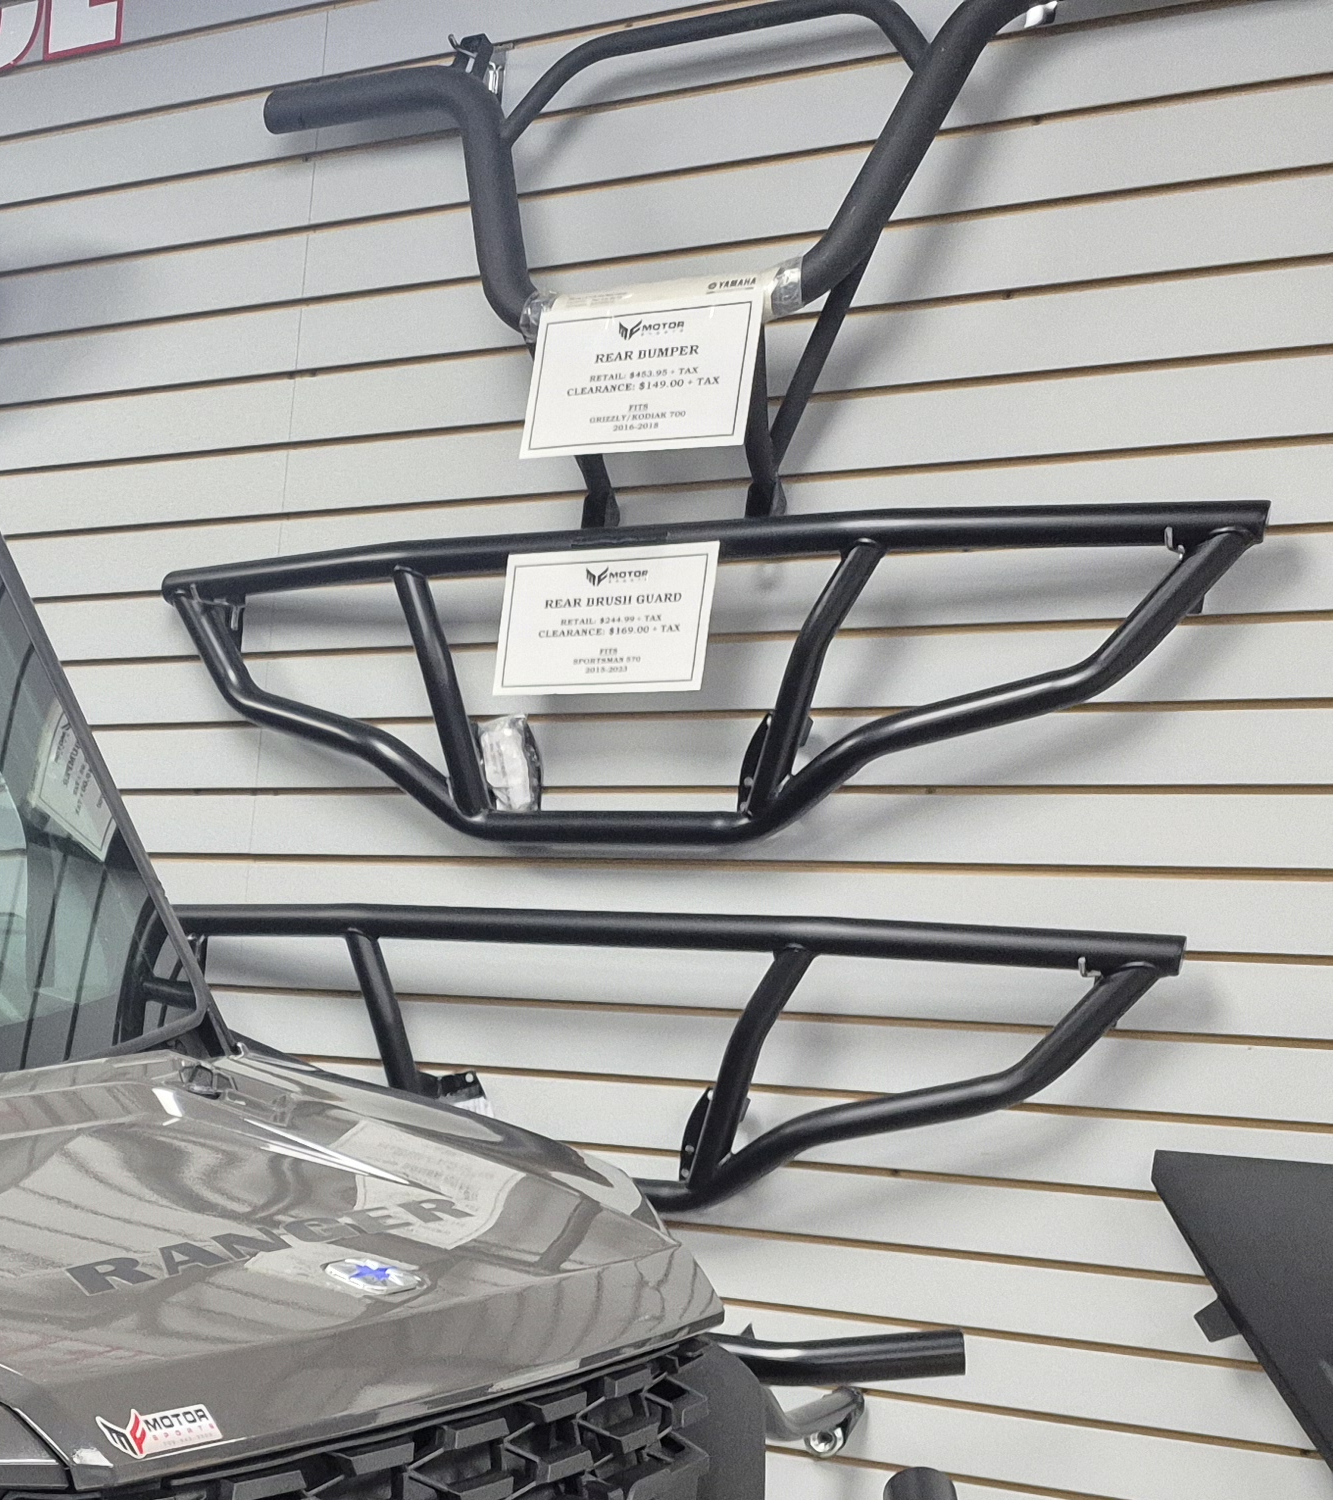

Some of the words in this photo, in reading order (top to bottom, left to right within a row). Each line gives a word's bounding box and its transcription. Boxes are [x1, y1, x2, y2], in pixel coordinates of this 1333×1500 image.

[718, 277, 757, 289] YAMAHA
[642, 321, 685, 332] MOTOR
[594, 350, 634, 364] REAR
[637, 344, 699, 360] BUMPER
[589, 372, 627, 383] RETAIL:
[678, 366, 699, 376] TAX
[567, 382, 636, 397] CLEARANCE:
[639, 379, 684, 391] $149.00
[697, 376, 720, 386] TAX
[628, 403, 649, 412] FITS
[669, 410, 686, 418] 700
[609, 570, 648, 579] MOTOR
[544, 598, 582, 609] REAR
[586, 595, 632, 607] BRUSH
[636, 592, 682, 605] GUARD
[644, 614, 662, 622] TAX
[538, 628, 605, 638] CLEARANCE:
[609, 625, 650, 636] $169.00
[661, 623, 681, 633] TAX
[599, 648, 618, 656] FITS
[573, 656, 624, 665] SPORTSMAN
[65, 1198, 475, 1297] RANGER
[143, 1408, 209, 1433] MOTOR
